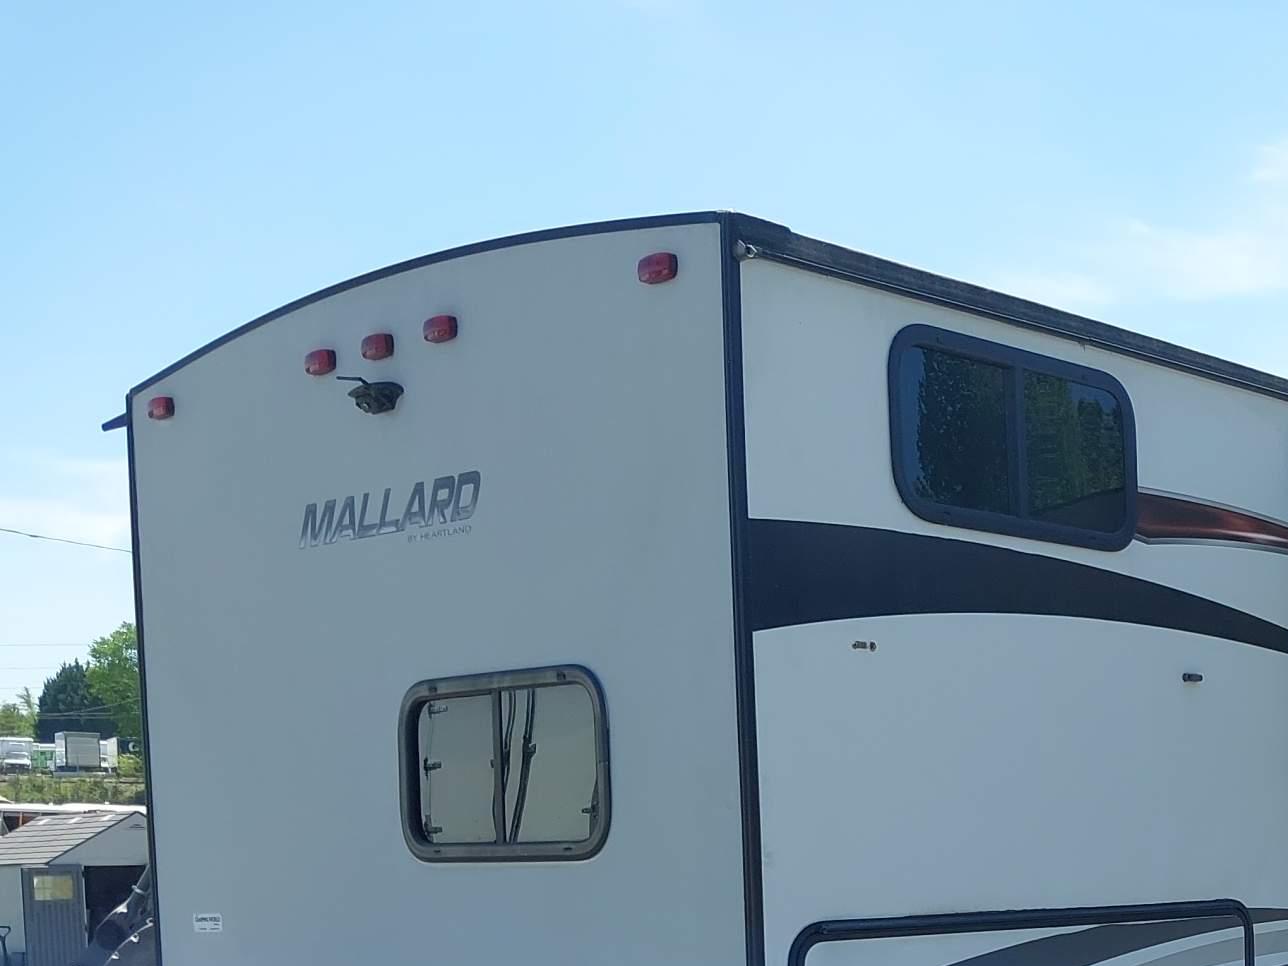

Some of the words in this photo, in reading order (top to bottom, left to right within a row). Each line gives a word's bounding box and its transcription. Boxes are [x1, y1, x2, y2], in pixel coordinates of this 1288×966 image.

[299, 470, 481, 550] MALLARD
[407, 531, 418, 543] BY
[420, 525, 472, 542] HEARTLAND
